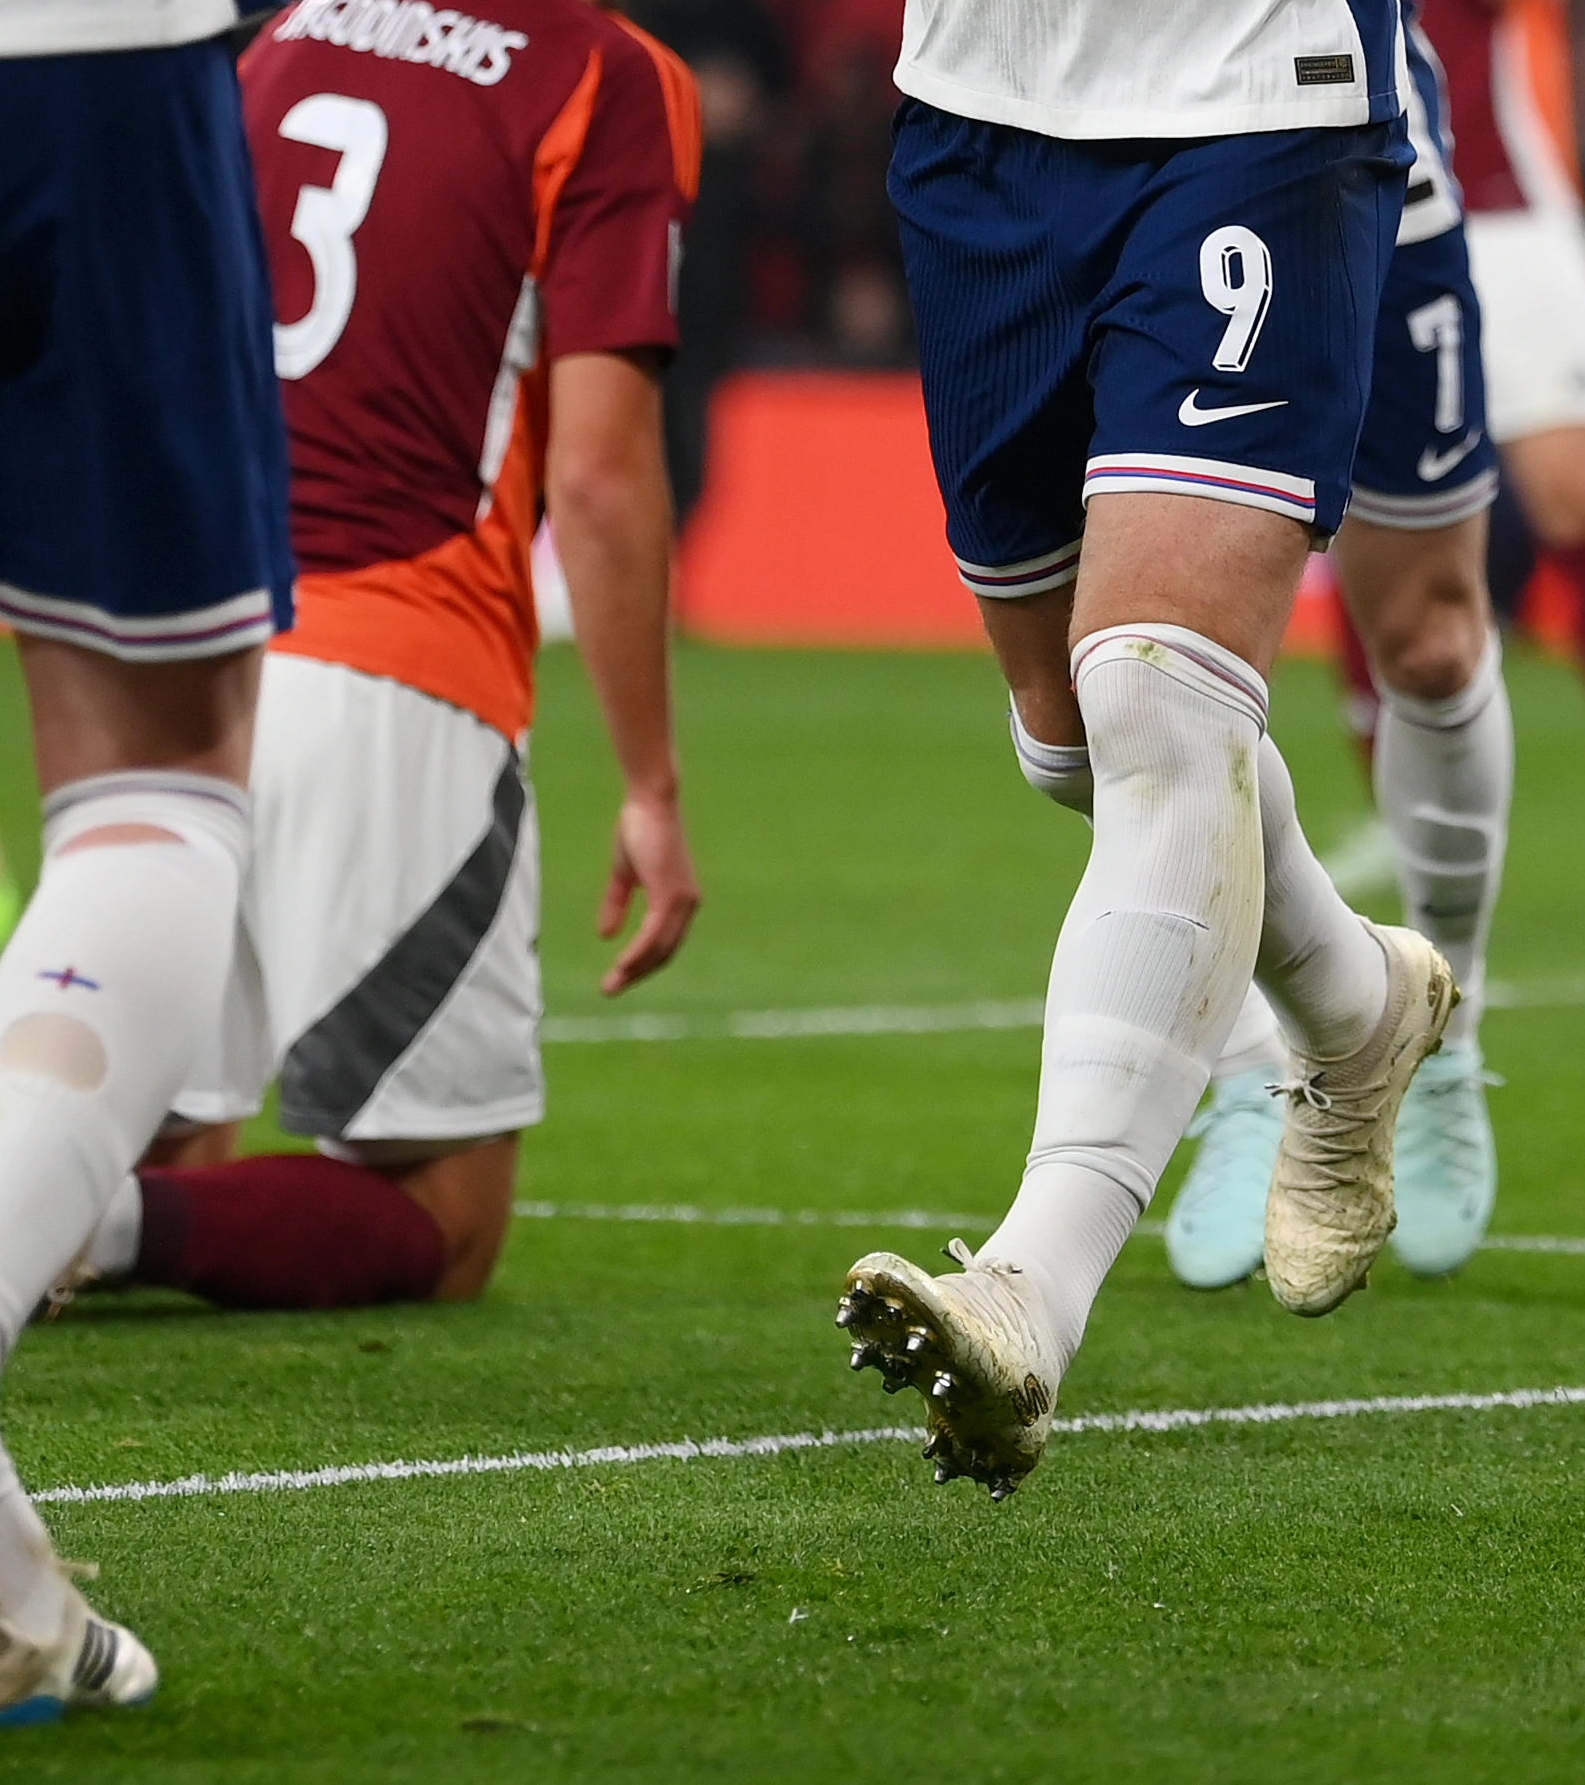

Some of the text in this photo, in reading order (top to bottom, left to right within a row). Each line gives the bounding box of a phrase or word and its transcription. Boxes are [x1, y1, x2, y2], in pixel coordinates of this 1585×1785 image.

[272, 92, 389, 380] 3
[1199, 225, 1273, 373] 9
[1406, 293, 1464, 434] 7
